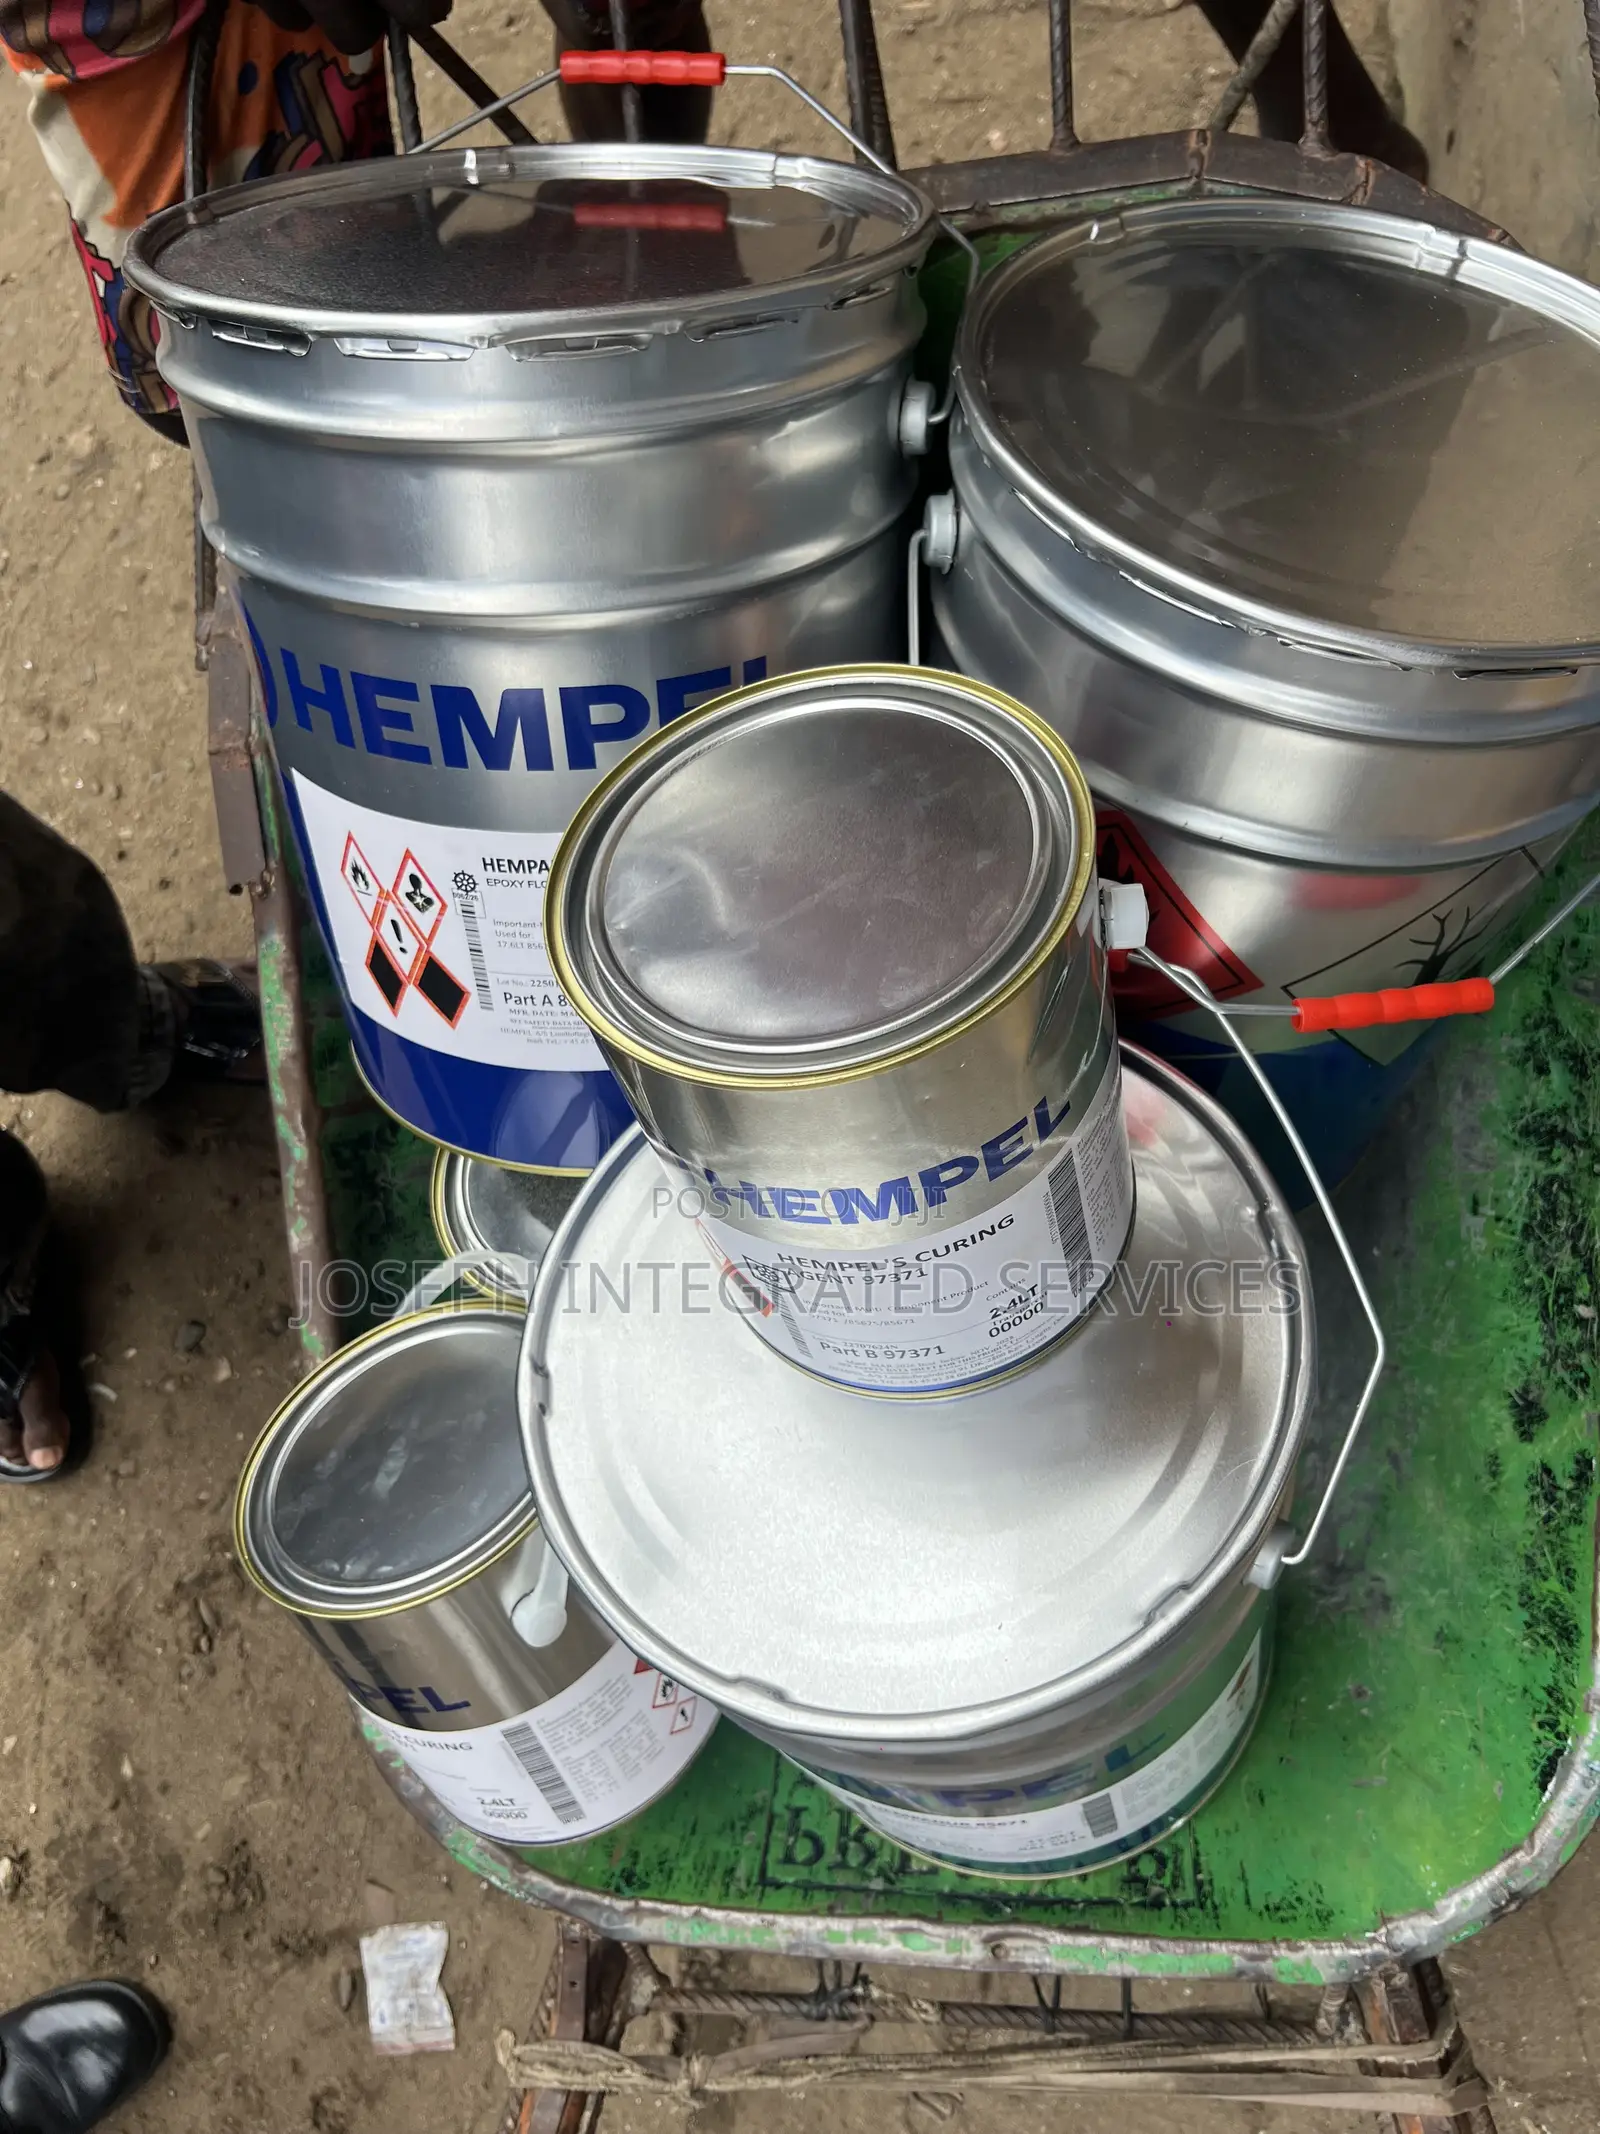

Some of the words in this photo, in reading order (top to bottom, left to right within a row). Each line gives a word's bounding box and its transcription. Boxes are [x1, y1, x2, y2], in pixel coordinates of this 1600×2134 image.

[280, 648, 768, 772] HEMPE
[482, 857, 552, 875] HEMPA
[486, 878, 525, 889] EPOXY
[495, 929, 517, 939] Used
[503, 991, 538, 1007] Part
[542, 994, 554, 1007] A
[557, 993, 570, 1008] 8
[702, 1096, 1072, 1226] HEMPEL
[777, 1252, 907, 1274] HEMPEL'S
[914, 1213, 1016, 1263] CURING
[787, 1267, 856, 1286] AGENT
[862, 1267, 929, 1286] 97371
[950, 1280, 990, 1299] Product
[985, 1277, 1027, 1302] Contains
[988, 1284, 1039, 1320] 2.4LT
[988, 1301, 1044, 1338] 00000
[819, 1341, 861, 1358] Part
[866, 1349, 878, 1360] B
[884, 1345, 947, 1360] 97371
